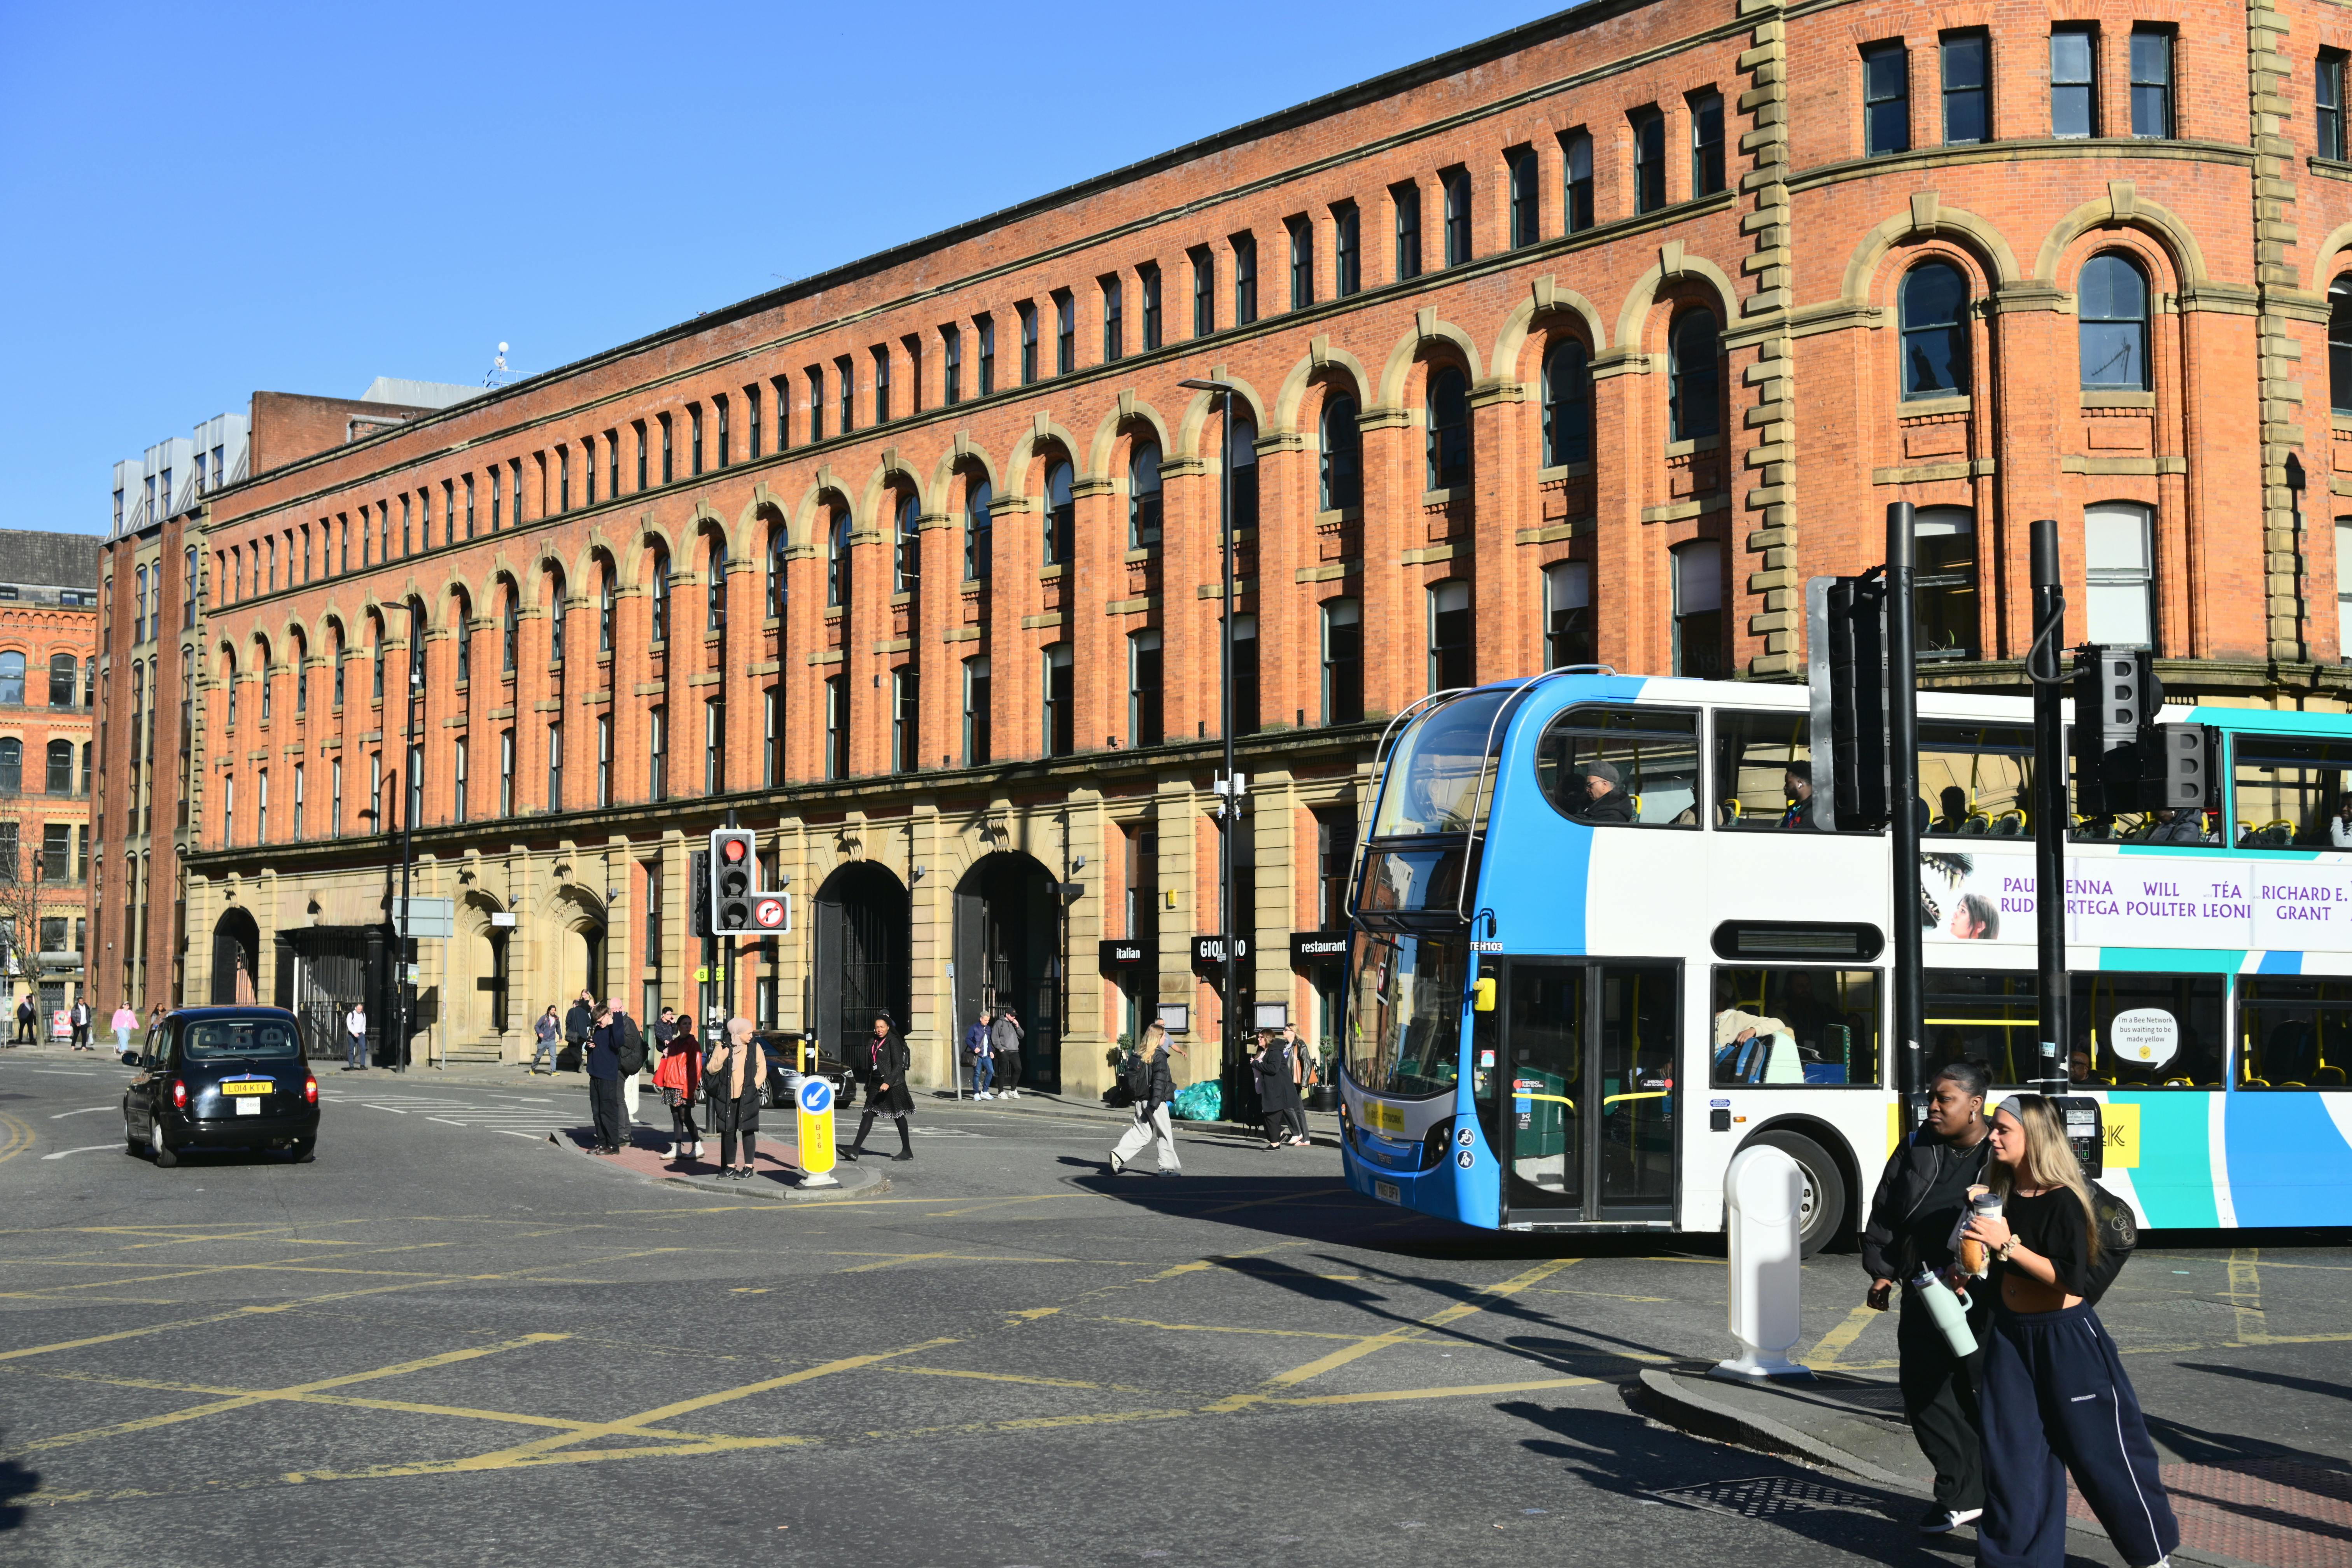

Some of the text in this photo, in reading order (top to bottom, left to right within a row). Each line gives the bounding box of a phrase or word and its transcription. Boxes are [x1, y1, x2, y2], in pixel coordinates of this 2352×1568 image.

[2004, 878, 2034, 892] PAU
[2066, 879, 2113, 894] ENNA
[2143, 882, 2180, 896] WILL
[2212, 881, 2242, 898] TÉA
[2262, 886, 2331, 901] RICHARD
[2336, 888, 2348, 901] E.
[2001, 898, 2037, 913] RUD
[2067, 900, 2119, 915] RTEGA
[2127, 901, 2196, 917] POULTER
[2203, 903, 2251, 918] LEONI
[2277, 906, 2331, 920] GRANT
[1116, 948, 1140, 959] italian
[1200, 940, 1246, 957] GIOIO
[1302, 940, 1346, 953] restaurant
[1470, 942, 1503, 951] TEH103
